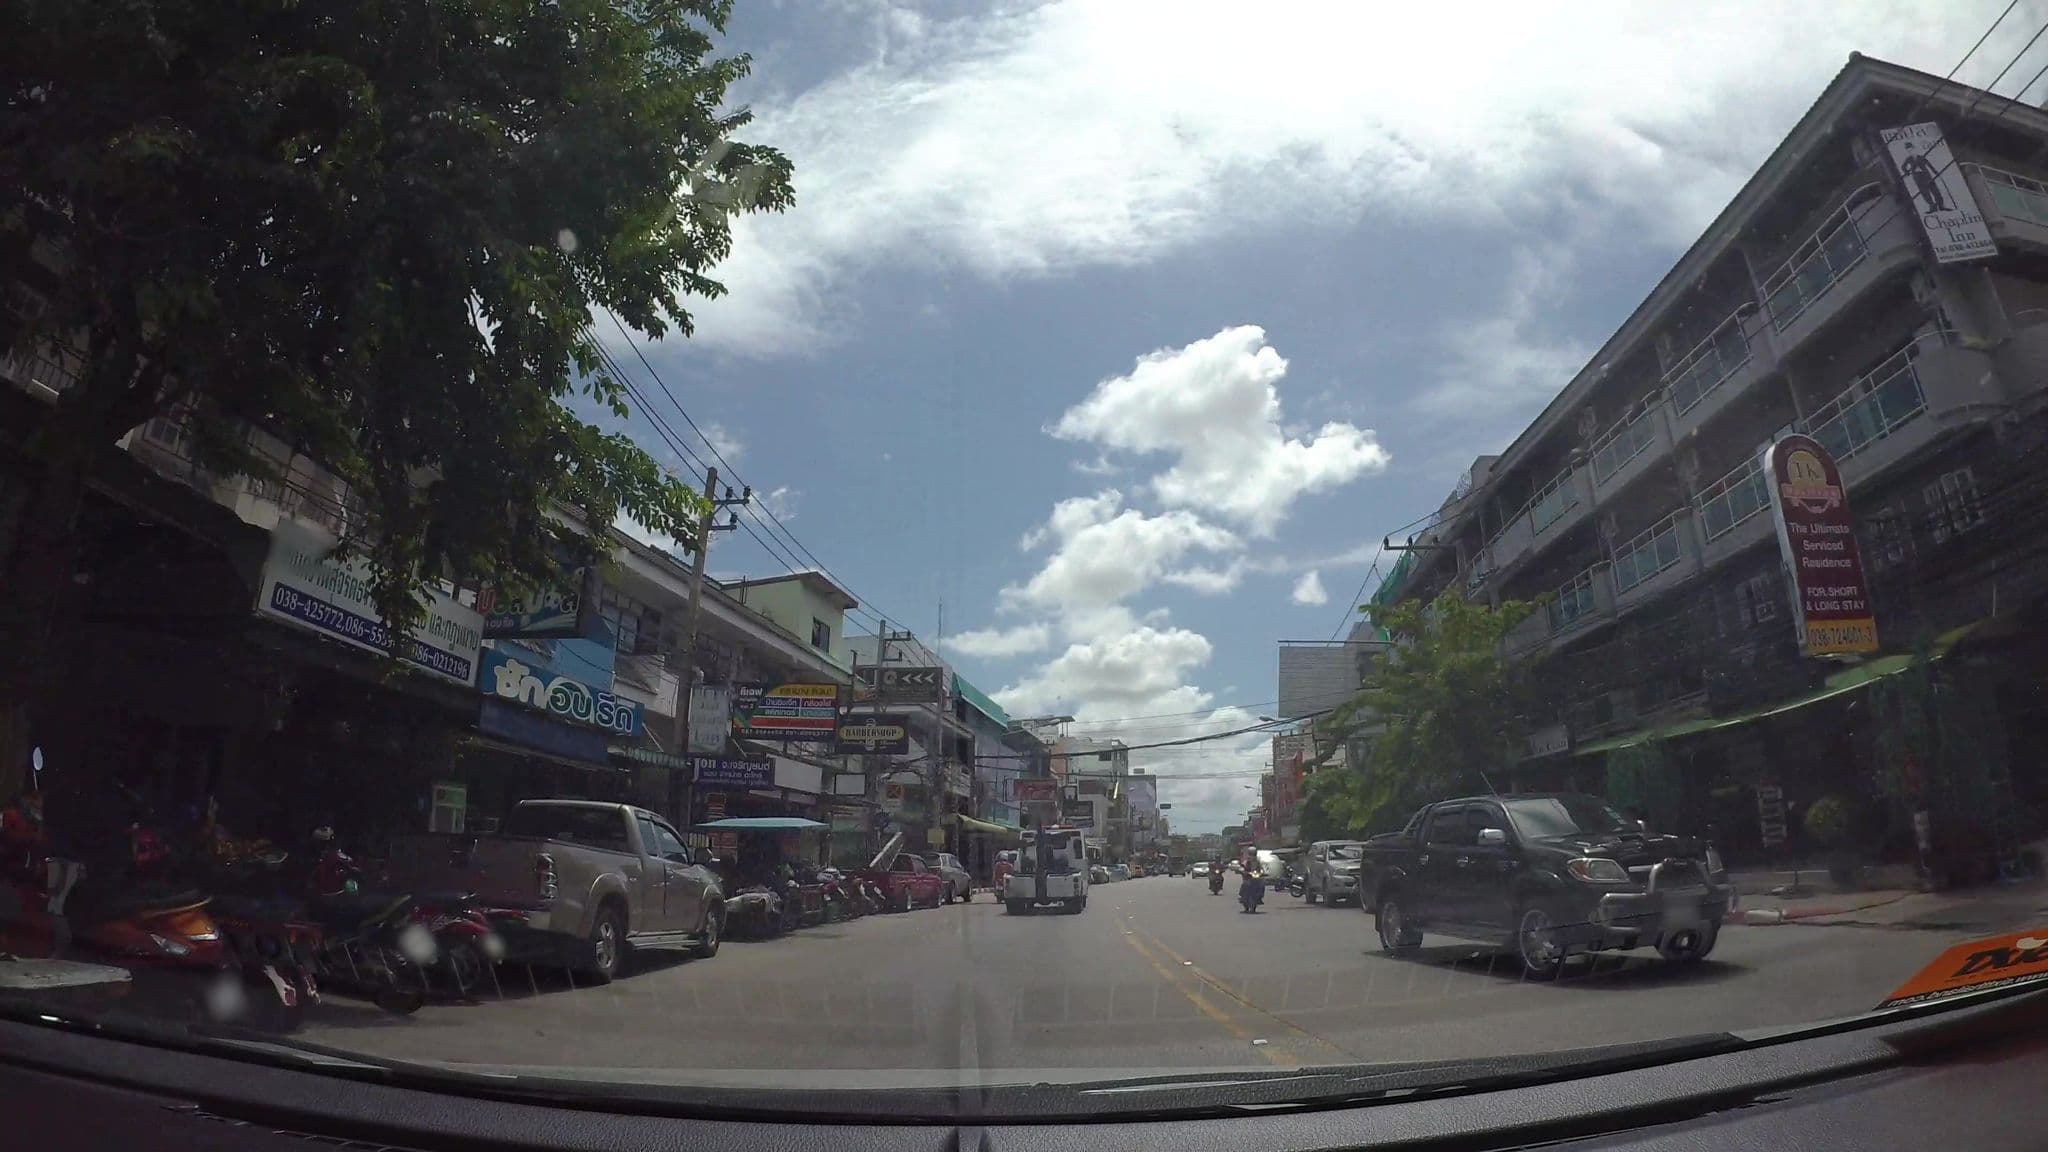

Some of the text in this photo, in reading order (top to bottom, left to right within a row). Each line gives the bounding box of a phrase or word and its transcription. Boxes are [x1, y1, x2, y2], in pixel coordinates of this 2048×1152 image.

[1923, 210, 1984, 231] Chaplin
[1948, 229, 1976, 243] Inn
[1787, 522, 1850, 534] The Ultimate
[1802, 539, 1844, 551] Serviced
[1802, 556, 1852, 569] Residence
[1807, 585, 1858, 597] FOR SHORT
[1806, 600, 1865, 611] & LONG STAY
